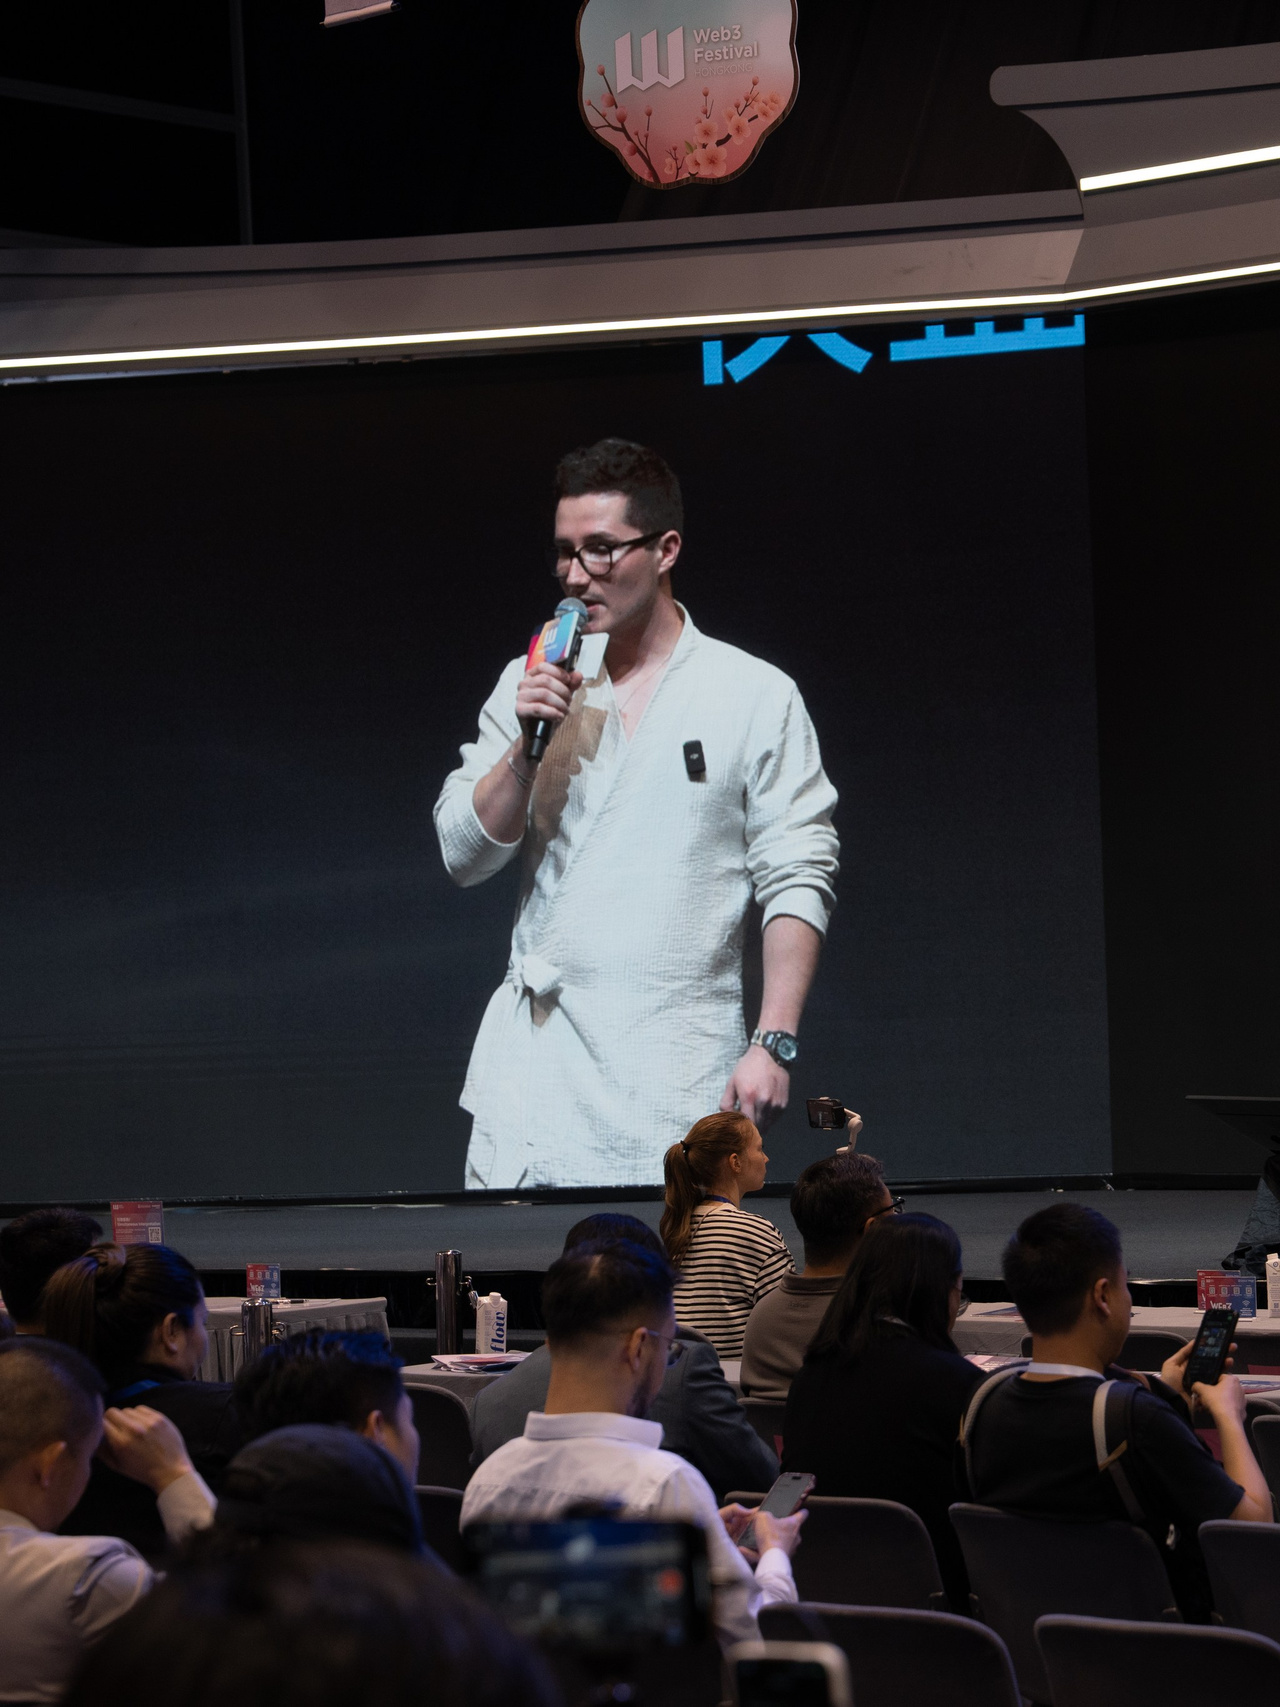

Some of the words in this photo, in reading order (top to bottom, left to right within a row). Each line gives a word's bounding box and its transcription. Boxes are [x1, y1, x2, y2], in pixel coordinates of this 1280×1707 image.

[693, 25, 741, 44] Web3
[694, 41, 759, 63] Festival
[694, 63, 753, 77] HONGKONG
